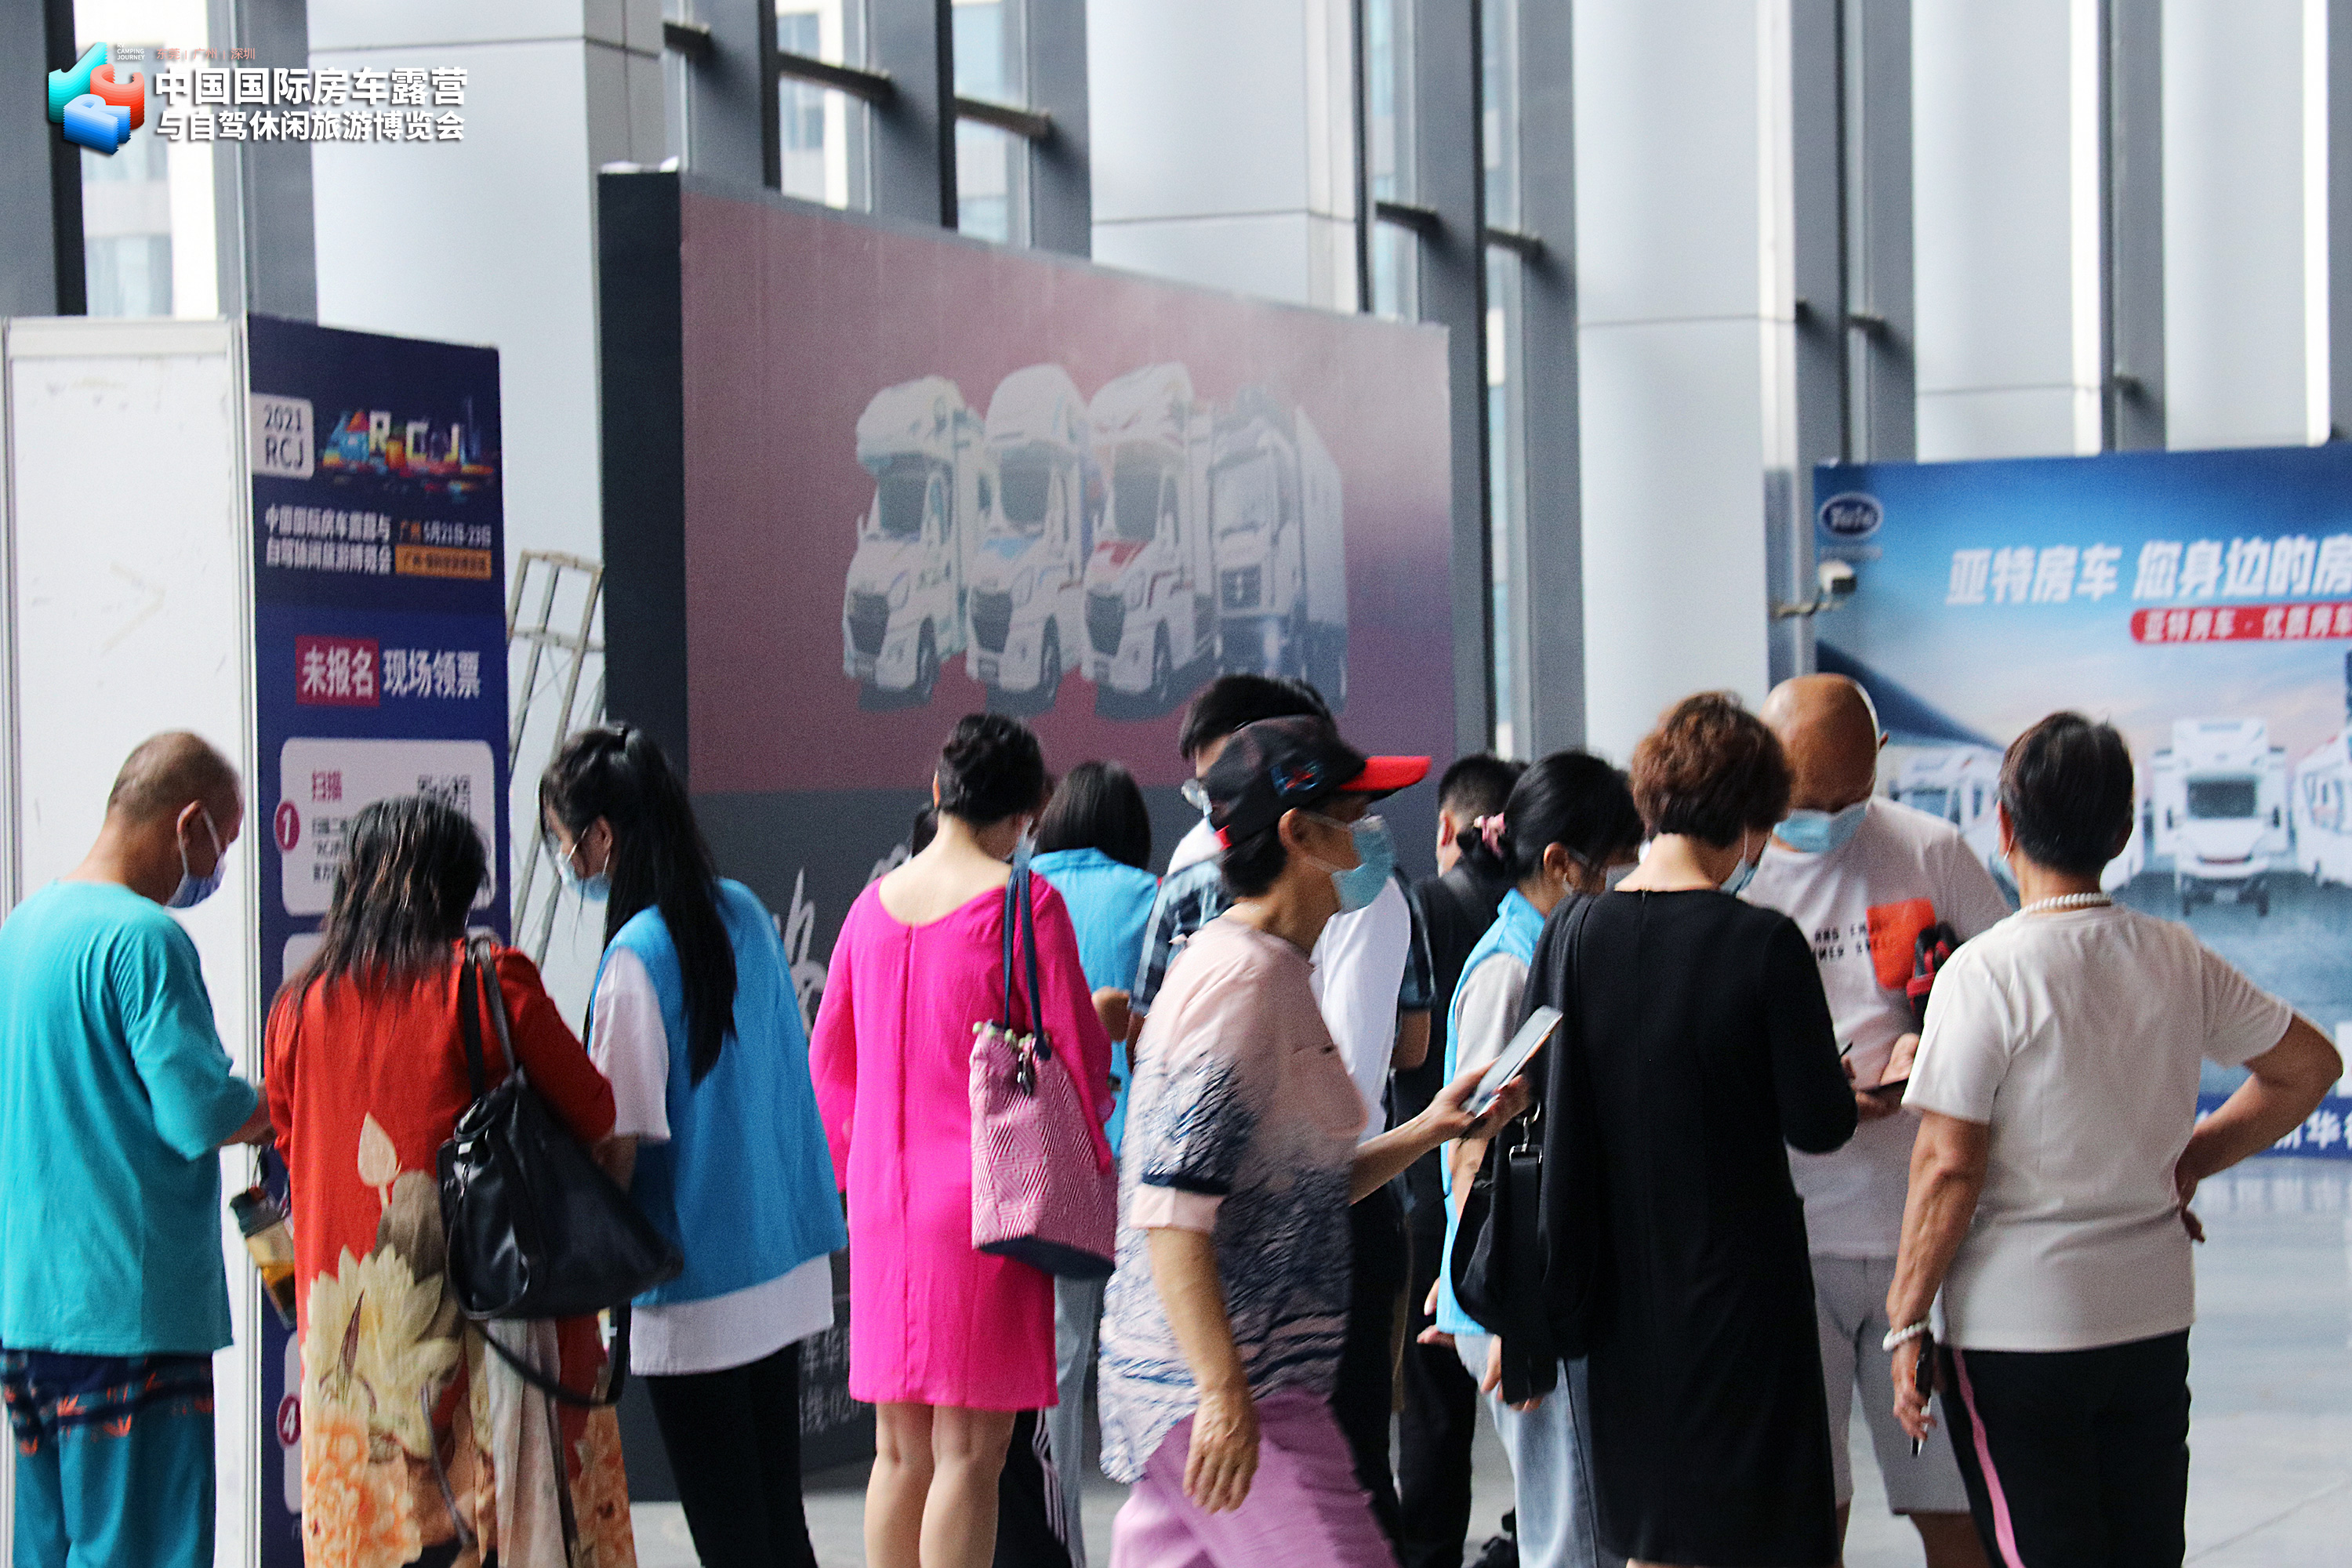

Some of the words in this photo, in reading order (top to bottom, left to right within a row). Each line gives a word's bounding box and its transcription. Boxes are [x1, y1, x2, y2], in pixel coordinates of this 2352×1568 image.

[263, 404, 302, 432] 2021
[265, 435, 304, 469] RCJ
[1946, 543, 2122, 604] 亚特房车
[2131, 534, 2352, 600] 您身边的房
[303, 644, 373, 698] 未报名
[383, 648, 480, 699] 现场领票
[281, 805, 292, 845] 1
[283, 1401, 296, 1442] 4
